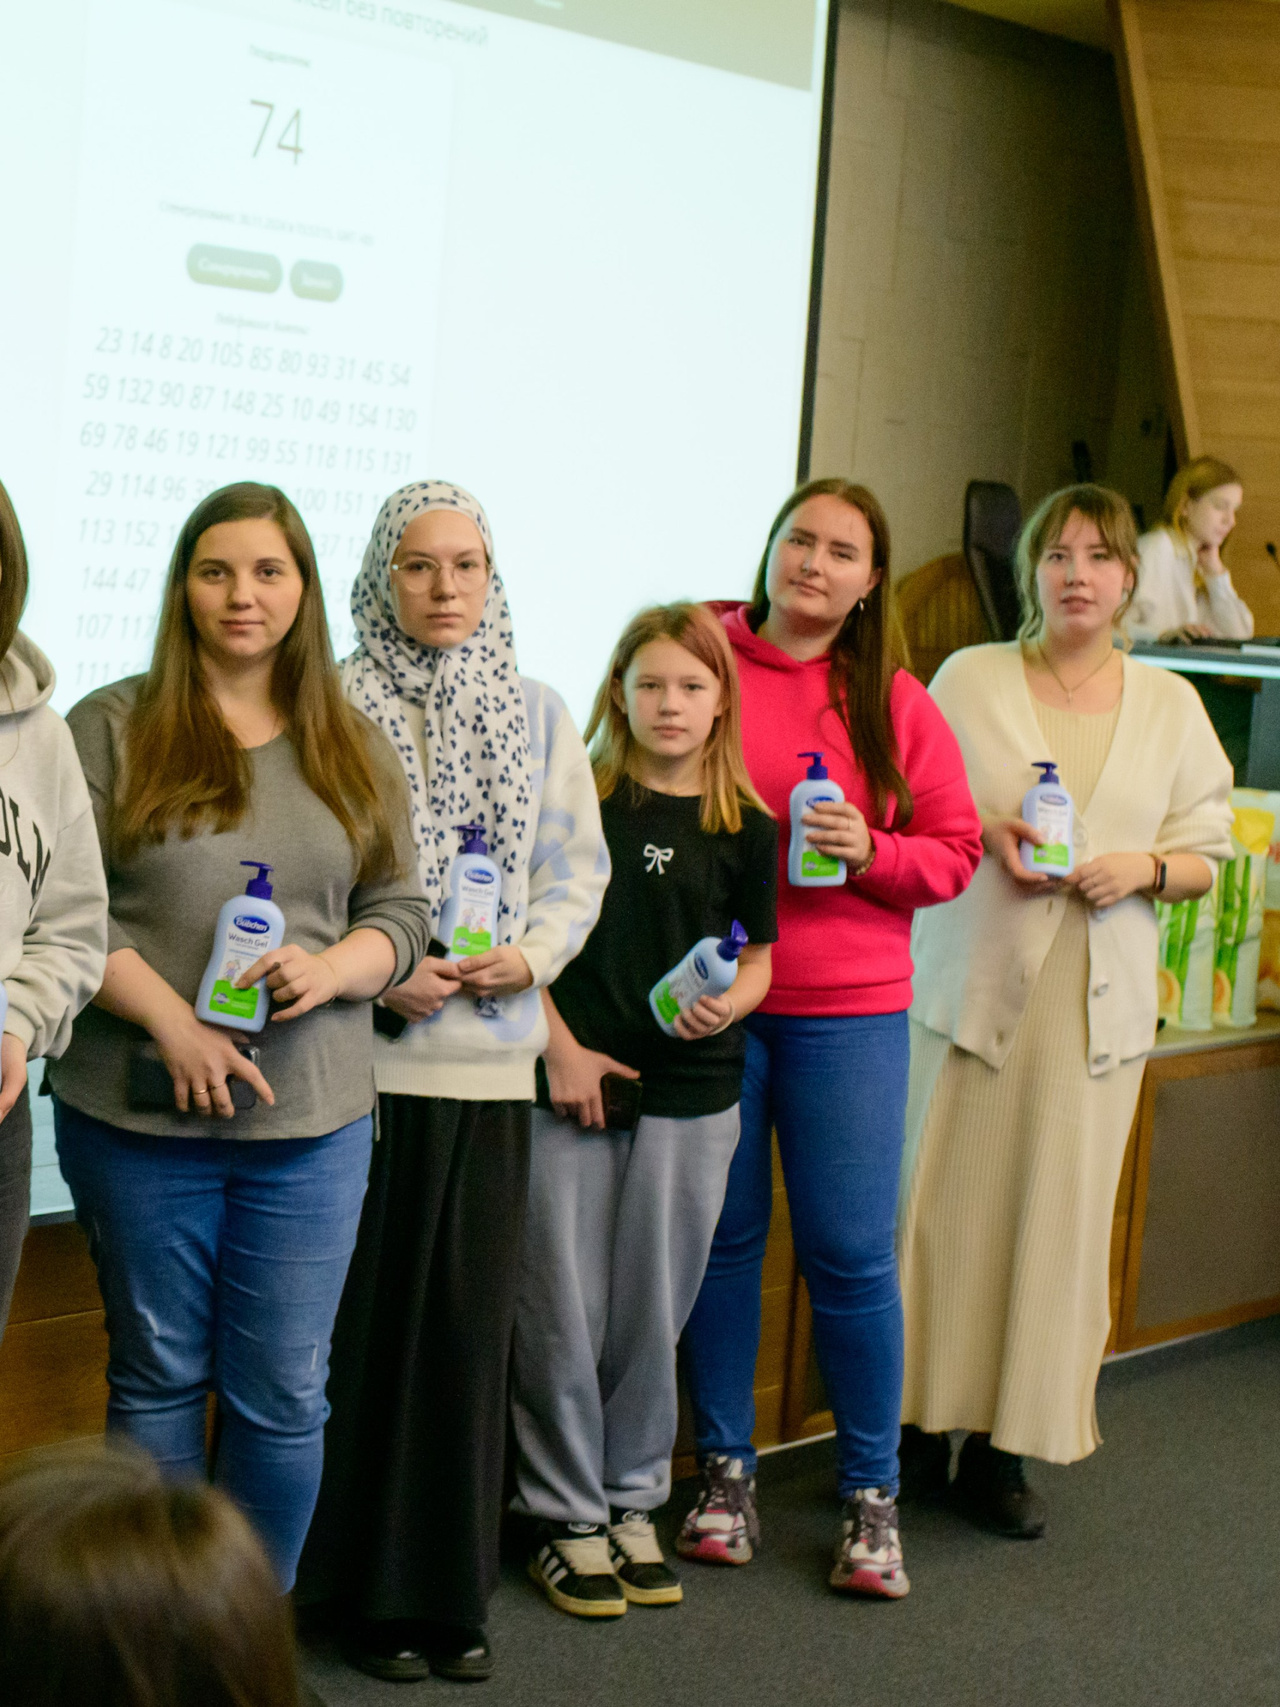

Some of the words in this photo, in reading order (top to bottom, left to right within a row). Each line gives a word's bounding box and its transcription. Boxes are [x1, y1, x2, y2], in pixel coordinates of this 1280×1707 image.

[249, 98, 305, 165] 74
[94, 326, 124, 354] 23
[131, 330, 155, 356] 14
[176, 335, 204, 363] 20
[210, 338, 244, 368] 105
[334, 356, 357, 381] 31
[361, 360, 385, 385] 45
[388, 362, 412, 388] 54
[82, 372, 110, 401] 59
[118, 376, 154, 406] 132
[159, 380, 185, 408] 90
[189, 384, 216, 410] 87
[223, 388, 257, 416] 148
[260, 392, 285, 419] 25
[292, 396, 314, 422] 10
[348, 402, 380, 428] 154
[385, 406, 418, 433] 130
[79, 420, 107, 448] 69
[113, 422, 139, 451] 78
[142, 427, 169, 454] 46
[177, 430, 200, 457] 19
[207, 433, 240, 460] 121
[274, 439, 299, 466] 55
[306, 443, 339, 469] 118
[345, 446, 376, 472] 115
[383, 450, 412, 475] 131
[84, 470, 114, 497] 29
[121, 472, 157, 499] 114
[162, 475, 186, 502] 96
[334, 490, 364, 515] 151
[80, 517, 116, 545] 113
[125, 520, 160, 548] 152
[83, 566, 119, 590] 144
[123, 567, 151, 592] 47
[76, 613, 114, 640] 107
[228, 933, 254, 945] Wasch
[255, 938, 269, 949] Gel
